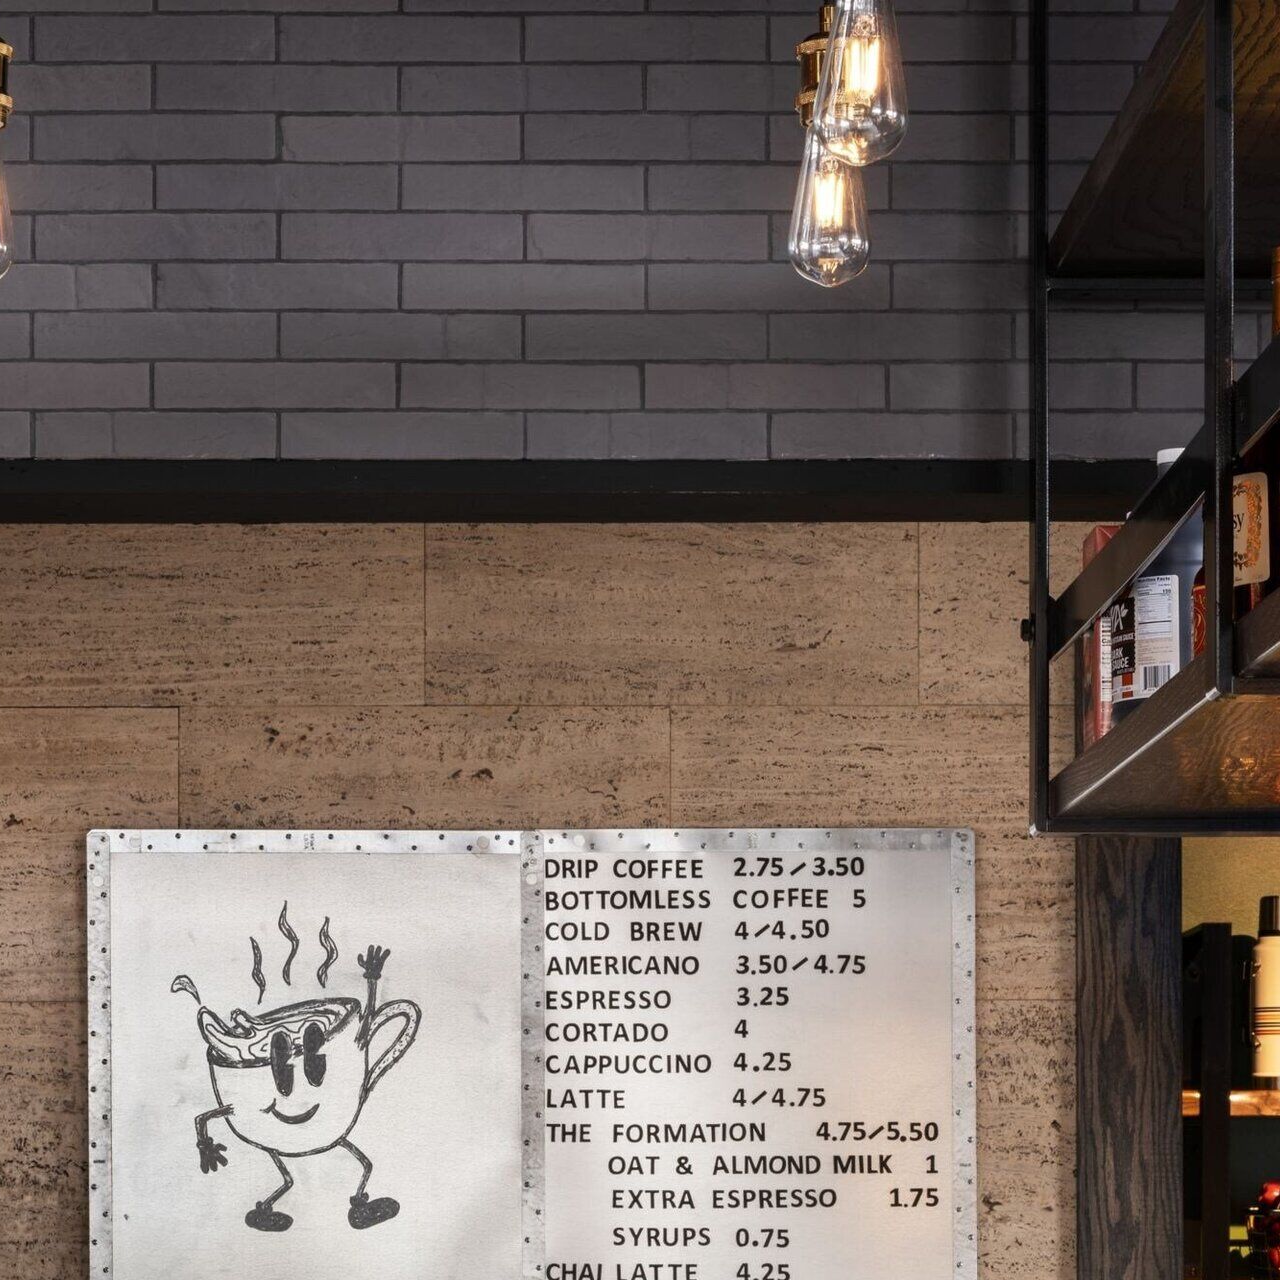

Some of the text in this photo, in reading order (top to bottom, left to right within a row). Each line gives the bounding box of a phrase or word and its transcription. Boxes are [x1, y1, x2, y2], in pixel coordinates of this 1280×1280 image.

[545, 859, 598, 879] DRIP
[613, 859, 703, 879] COFFEE
[545, 888, 866, 911] BOTTOMLESS COFFEE 5
[545, 922, 610, 942] COLD
[630, 922, 703, 942] BREW
[546, 956, 700, 976] AMERICANO
[545, 987, 790, 1010] ESPRESSO 3.25
[545, 1019, 749, 1043] CORTADO 4
[545, 1052, 792, 1075] CAPPUCCINO 4.25
[546, 1089, 626, 1109] LATTE
[546, 1123, 592, 1143] THE
[612, 1123, 766, 1143] FORMATION
[608, 1155, 939, 1175] OAT & ALMOND MILK 1
[612, 1188, 940, 1210] EXTRA ESPRESSO 1.75
[612, 1227, 790, 1249] SYRUPS 0.75
